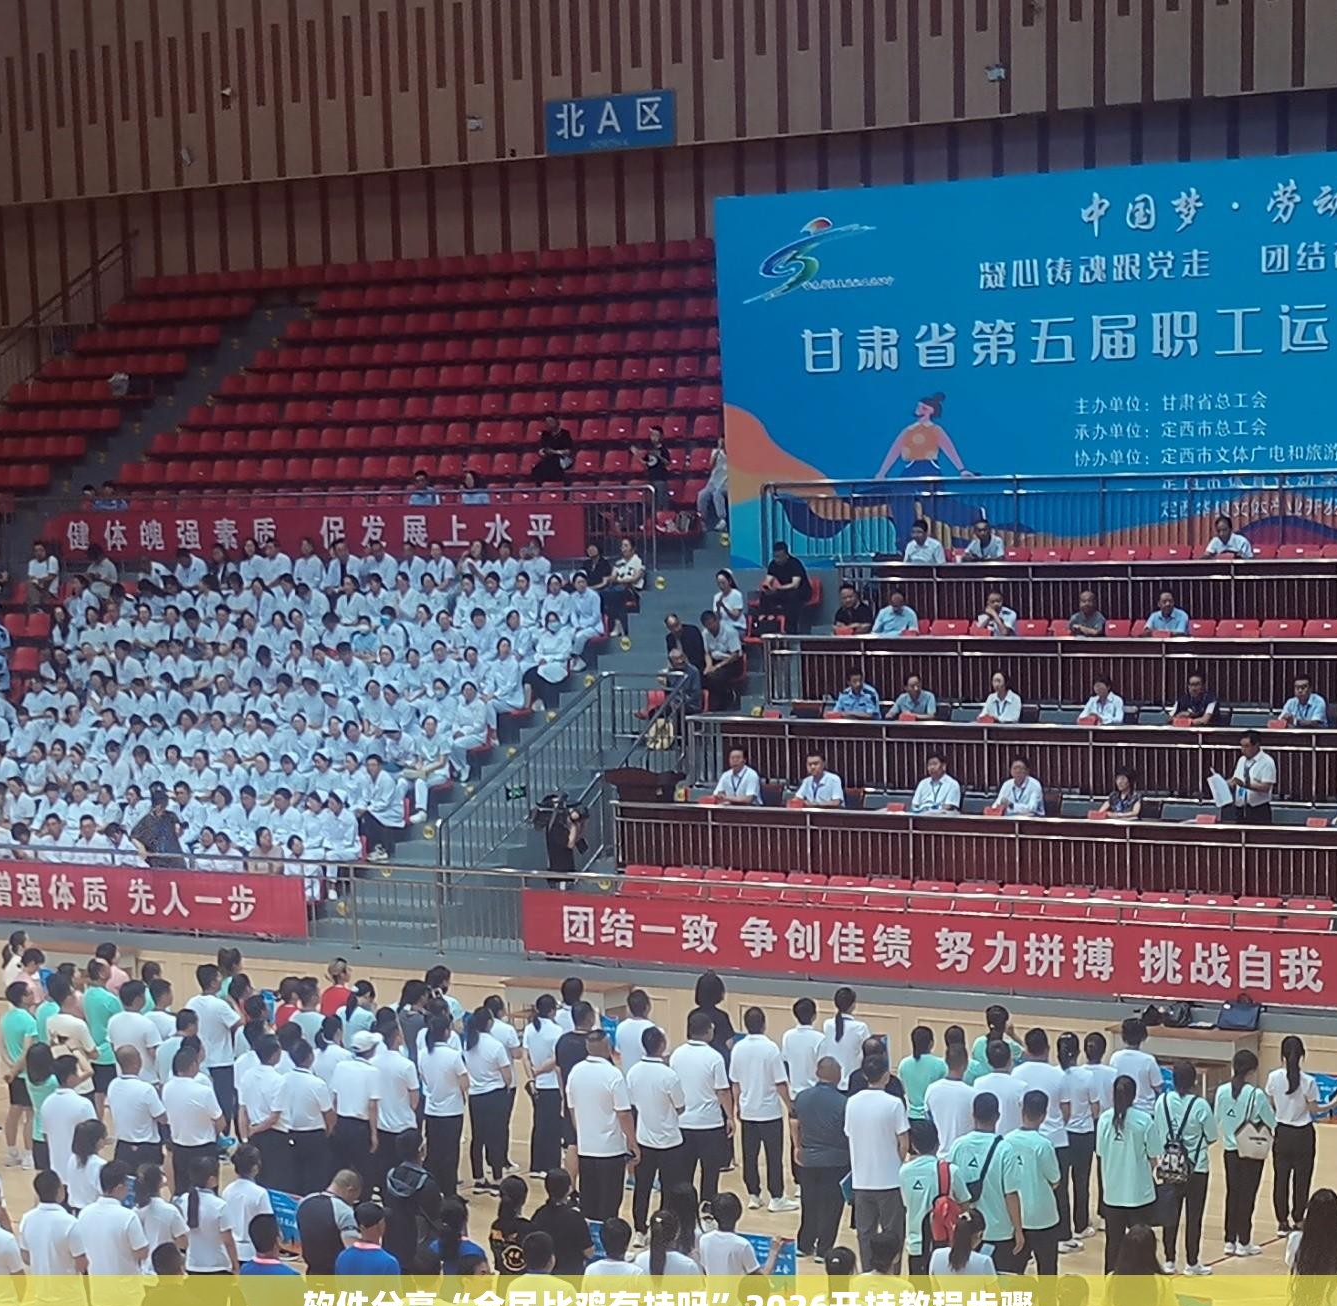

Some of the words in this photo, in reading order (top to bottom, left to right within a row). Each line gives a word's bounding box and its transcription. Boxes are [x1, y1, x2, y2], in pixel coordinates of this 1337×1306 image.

[978, 248, 1211, 290] 凝心铸魂跟党走
[319, 513, 556, 550] 促发展上水平
[127, 878, 257, 921] 先人一步
[561, 906, 718, 956] 团结一致
[739, 915, 912, 966] 争创佳绩
[935, 929, 1115, 982] 努力拼搏
[1138, 939, 1325, 994] 挑战自我
